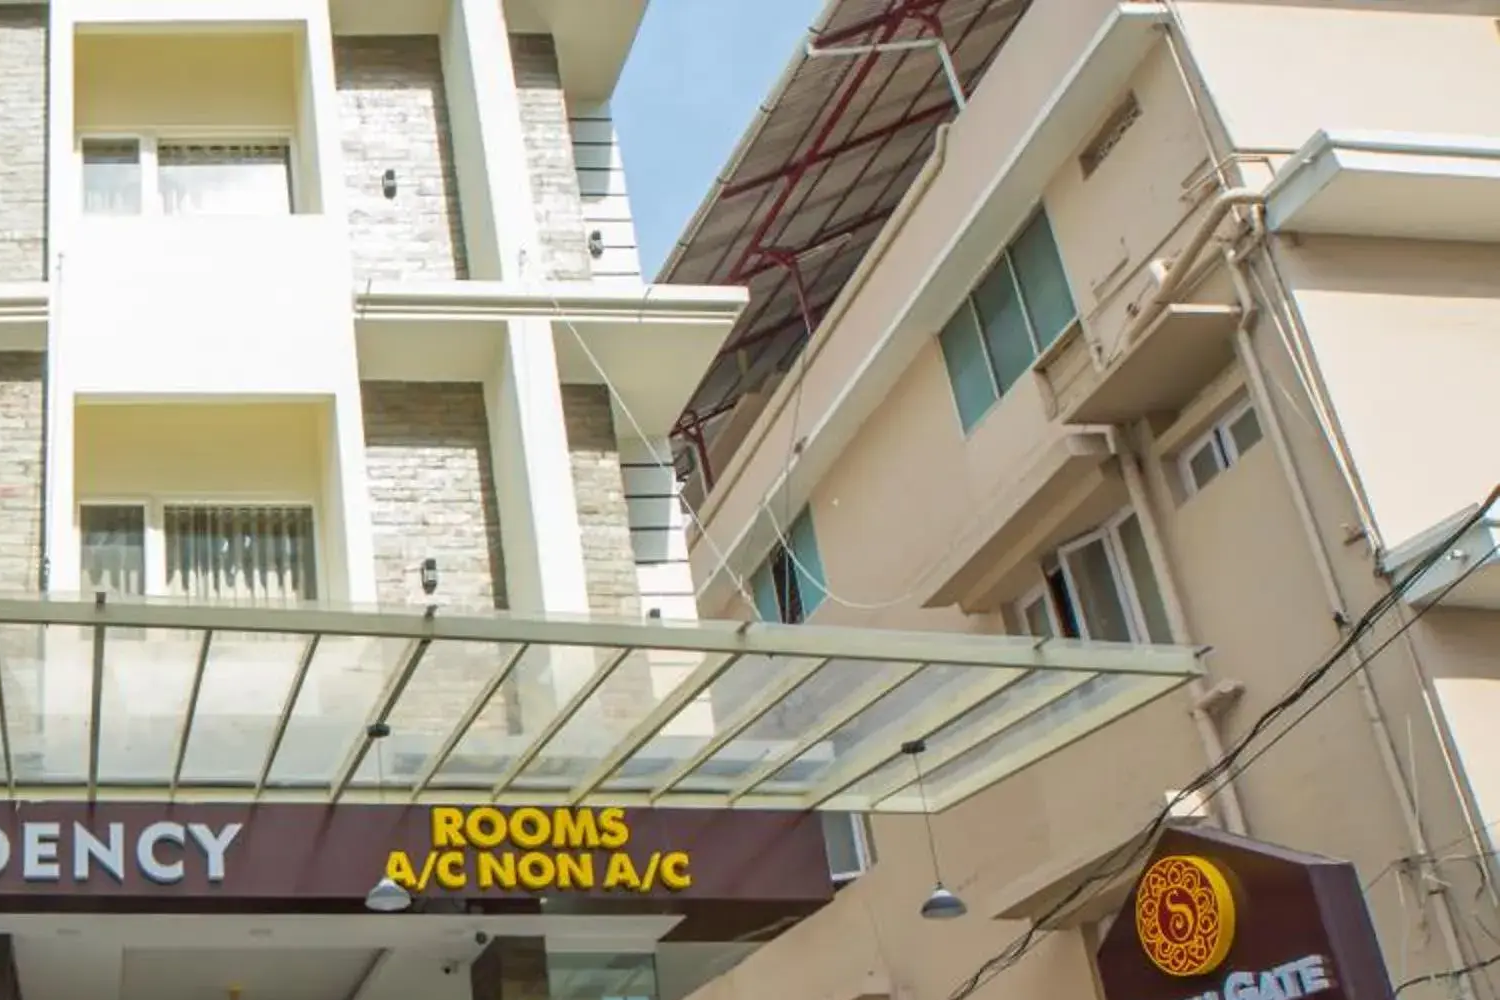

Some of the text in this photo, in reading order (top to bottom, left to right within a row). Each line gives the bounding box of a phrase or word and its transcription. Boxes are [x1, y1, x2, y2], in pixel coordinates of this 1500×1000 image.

[431, 806, 630, 849] ROOMS
[385, 851, 691, 892] A/C NON A/C
